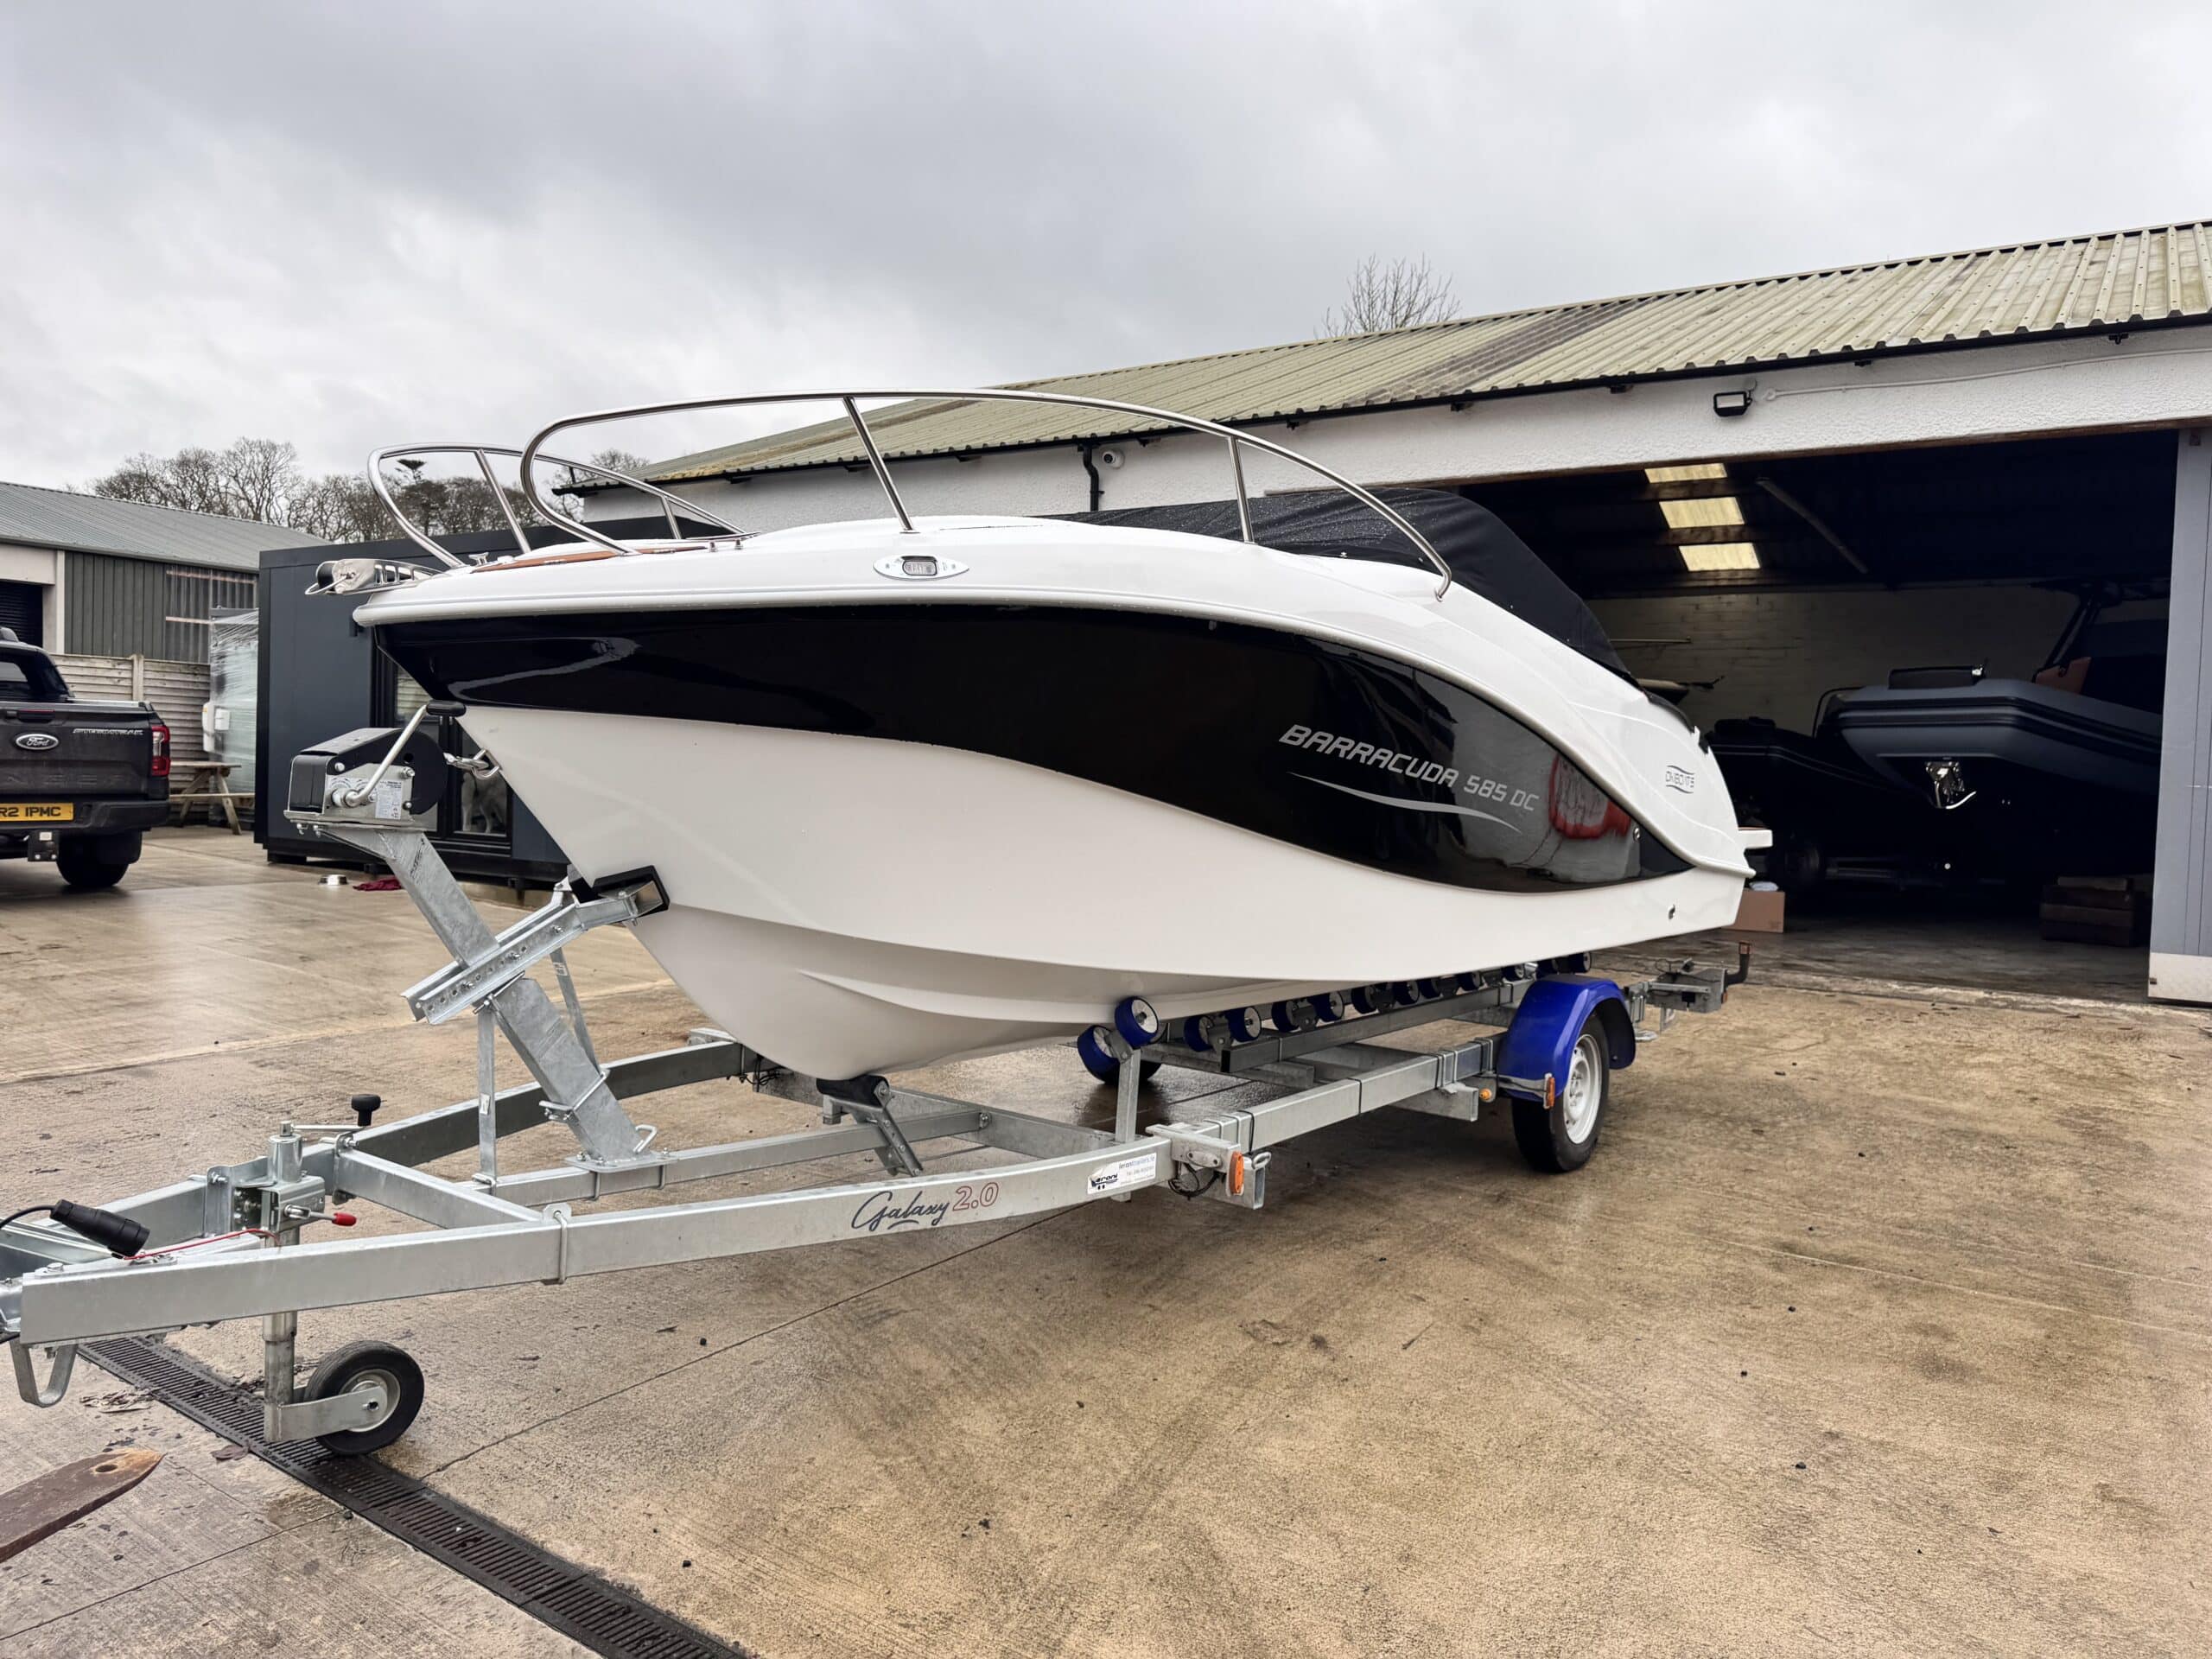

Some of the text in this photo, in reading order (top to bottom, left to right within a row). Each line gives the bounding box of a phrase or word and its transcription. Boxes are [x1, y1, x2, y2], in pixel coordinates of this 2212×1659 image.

[26, 736, 50, 747] Ford
[1279, 724, 1540, 811] BARRACUDA 585 DC
[851, 1181, 1000, 1231] Galaxy 2.0
